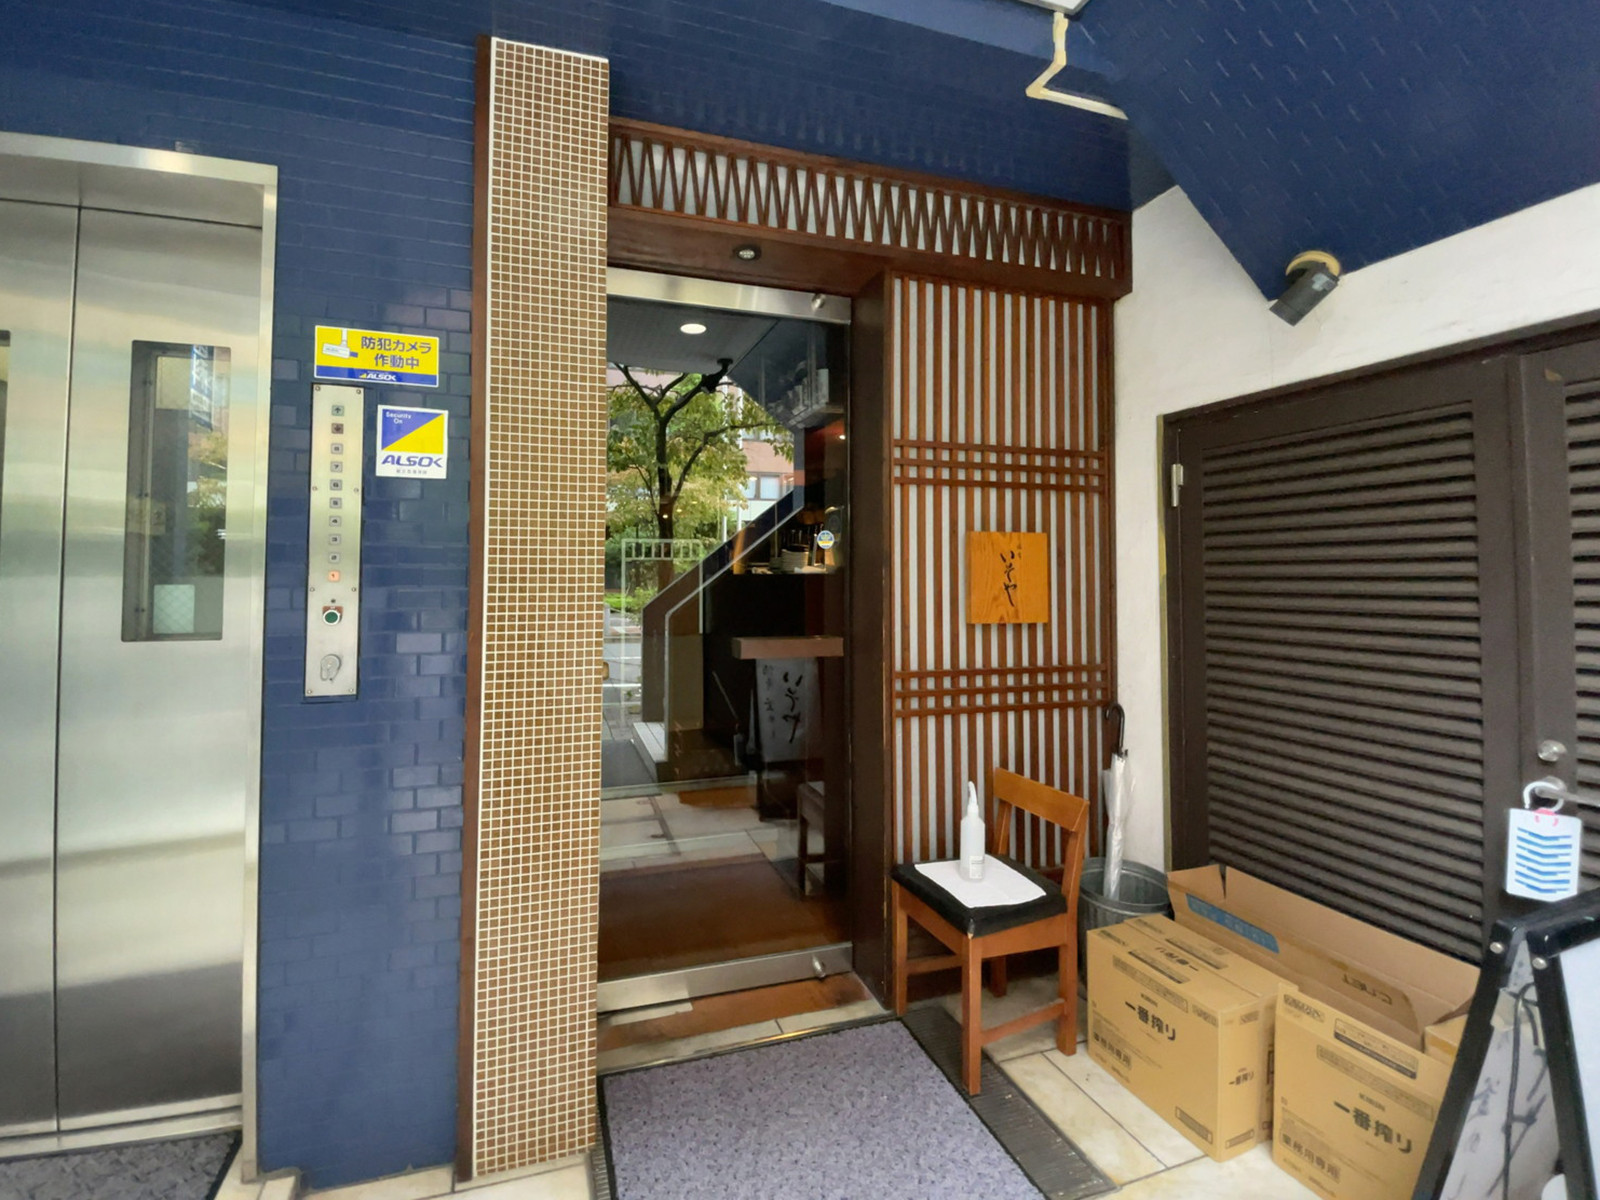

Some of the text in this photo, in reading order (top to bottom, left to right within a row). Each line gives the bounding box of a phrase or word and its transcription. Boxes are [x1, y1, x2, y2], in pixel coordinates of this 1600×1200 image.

[361, 336, 432, 354] 防犯カメラ
[374, 353, 420, 370] 作動中
[367, 372, 397, 381] ALSOK
[386, 411, 412, 419] Security
[381, 454, 443, 468] ALSOK
[1125, 1001, 1176, 1041] 一番搾り
[1333, 1100, 1412, 1154] 一番搾り
